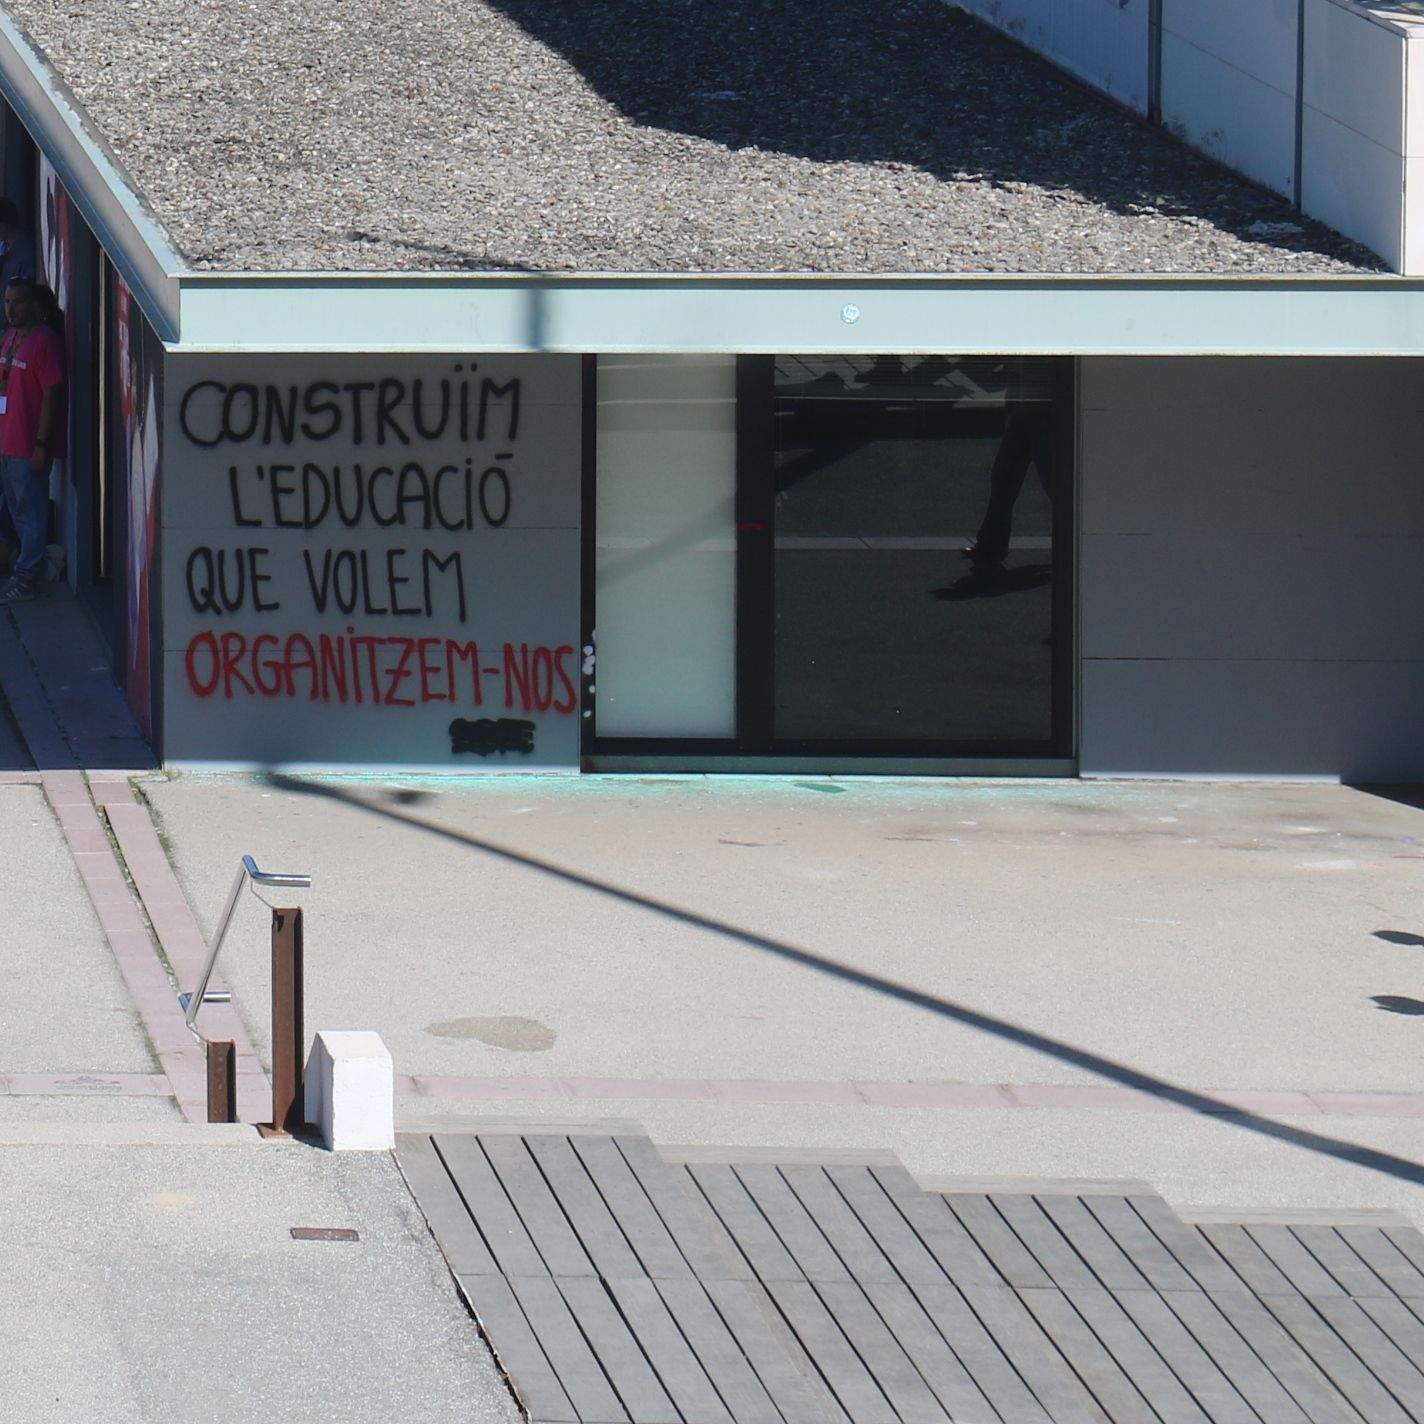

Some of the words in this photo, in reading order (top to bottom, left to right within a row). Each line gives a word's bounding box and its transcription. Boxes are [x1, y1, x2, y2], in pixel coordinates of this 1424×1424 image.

[178, 362, 522, 449] CONSTRUÏM
[227, 452, 515, 531] L'EDUCACIÓ
[185, 546, 281, 617] QUE
[302, 547, 467, 623] VOLEM
[184, 626, 578, 715] ORGANITZEM-NOS
